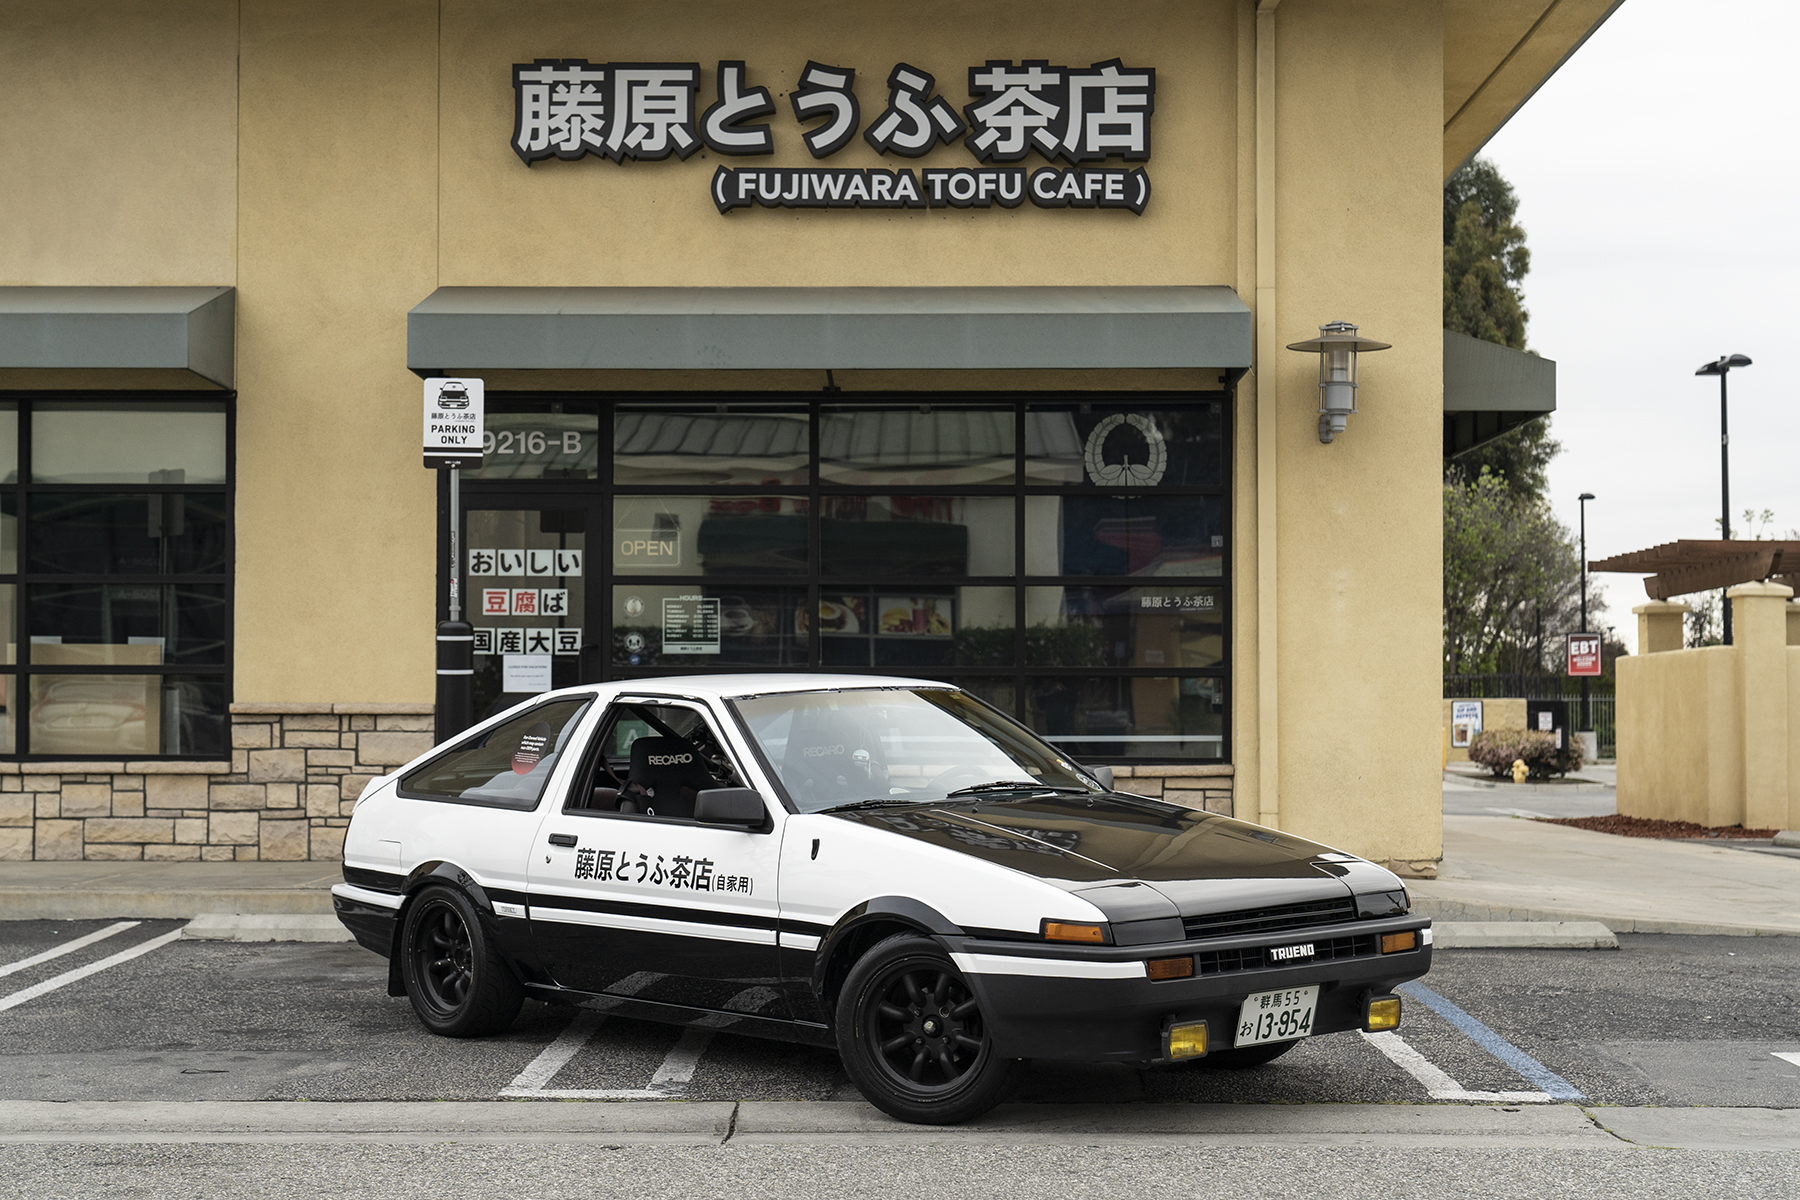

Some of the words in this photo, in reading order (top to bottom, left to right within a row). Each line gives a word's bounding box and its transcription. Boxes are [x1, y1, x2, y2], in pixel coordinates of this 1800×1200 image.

[518, 66, 1149, 153] 藤原とうふ茶店
[927, 172, 1021, 200] TOFU
[431, 424, 475, 434] PARKING
[440, 435, 468, 444] ONLY
[483, 430, 582, 455] 9216-B
[620, 540, 674, 556] OPEN
[471, 551, 580, 573] おいしい
[1141, 595, 1214, 608] 藤原とうふ茶店
[473, 630, 580, 652] 国産大豆
[1571, 640, 1598, 655] EBT
[623, 728, 639, 749] A
[648, 752, 693, 766] RECARO
[803, 744, 845, 757] RECARO
[1270, 943, 1315, 961] TRUENO
